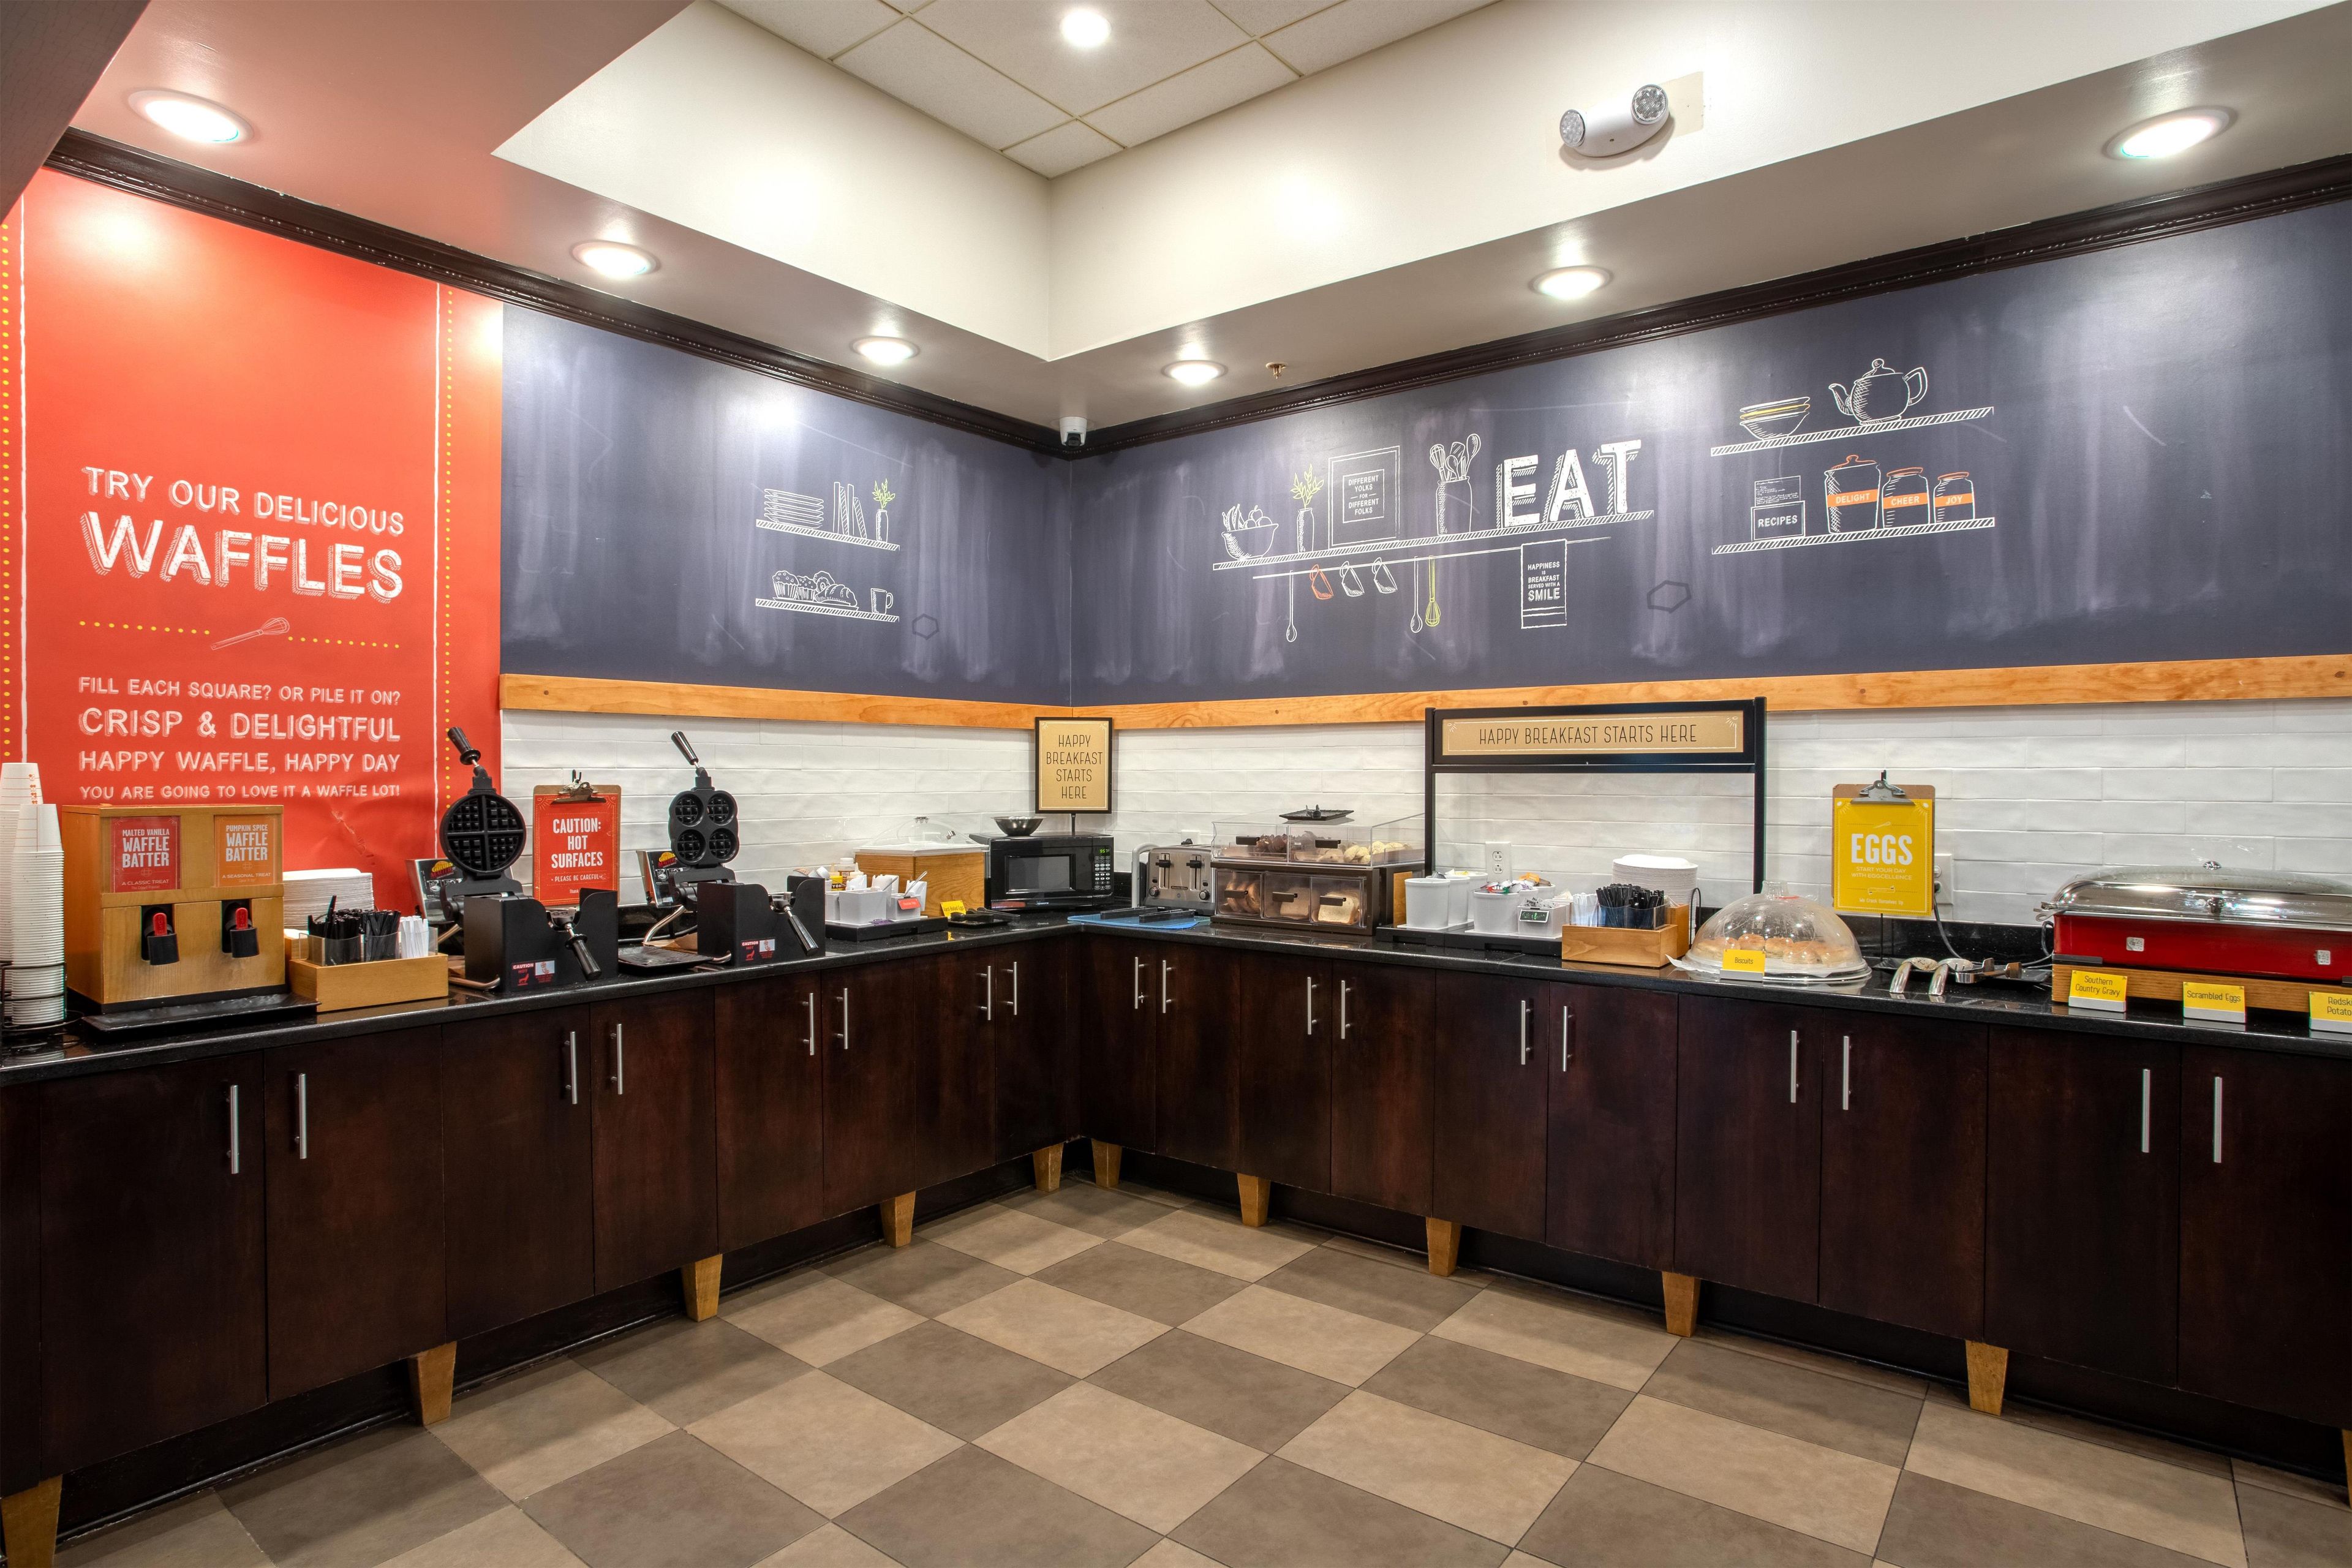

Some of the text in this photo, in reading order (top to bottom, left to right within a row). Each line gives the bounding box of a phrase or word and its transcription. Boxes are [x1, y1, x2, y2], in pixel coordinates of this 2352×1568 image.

[1349, 475, 1379, 486] DIFFERENT
[1496, 439, 1642, 529] EAT
[1355, 484, 1373, 492] YOLKS
[81, 466, 404, 537] TRY OUR DELICIOUS
[1349, 498, 1379, 508] DIFFERENT
[1836, 492, 1871, 504] DELIGHT
[1891, 496, 1920, 506] CHEER
[1945, 496, 1962, 505] JOY
[1355, 507, 1373, 515] FOLKS
[1758, 515, 1798, 528] RECIPES
[80, 511, 403, 604] WAFFLES
[1528, 561, 1560, 570] HAPPINESS
[1528, 575, 1559, 583] BREAKFAST
[1528, 587, 1560, 601] SMILE
[78, 677, 401, 705] FILL EACH SQUARE? OR PILE IT ON?
[78, 707, 401, 742] CRISP & DELIGHTFUL
[1058, 734, 1091, 747] HAPPY
[1479, 724, 1697, 744] HAPPY BREAKFAST STARTS HERE
[79, 751, 401, 774] HAPPY WAFFLE, HAPPY DAY
[1046, 752, 1102, 764] BREAKFAST
[1056, 769, 1092, 782] STARTS
[80, 785, 400, 799] YOU ARE GOING TO LOVE IT A WAFFLE LOT!
[1061, 786, 1087, 799] HERE
[553, 818, 601, 834] CAUTION:
[123, 836, 170, 852] WAFFLE
[226, 832, 268, 846] WAFFLE
[567, 835, 588, 850] HOT
[225, 846, 268, 862] BATTER
[1851, 833, 1913, 865] EGGS
[123, 852, 170, 868] BATTER
[551, 851, 603, 869] SURFACES
[2084, 975, 2113, 986] Southern
[2075, 984, 2120, 997] Country Gravy
[2187, 990, 2241, 1003] Scrambled Eggs
